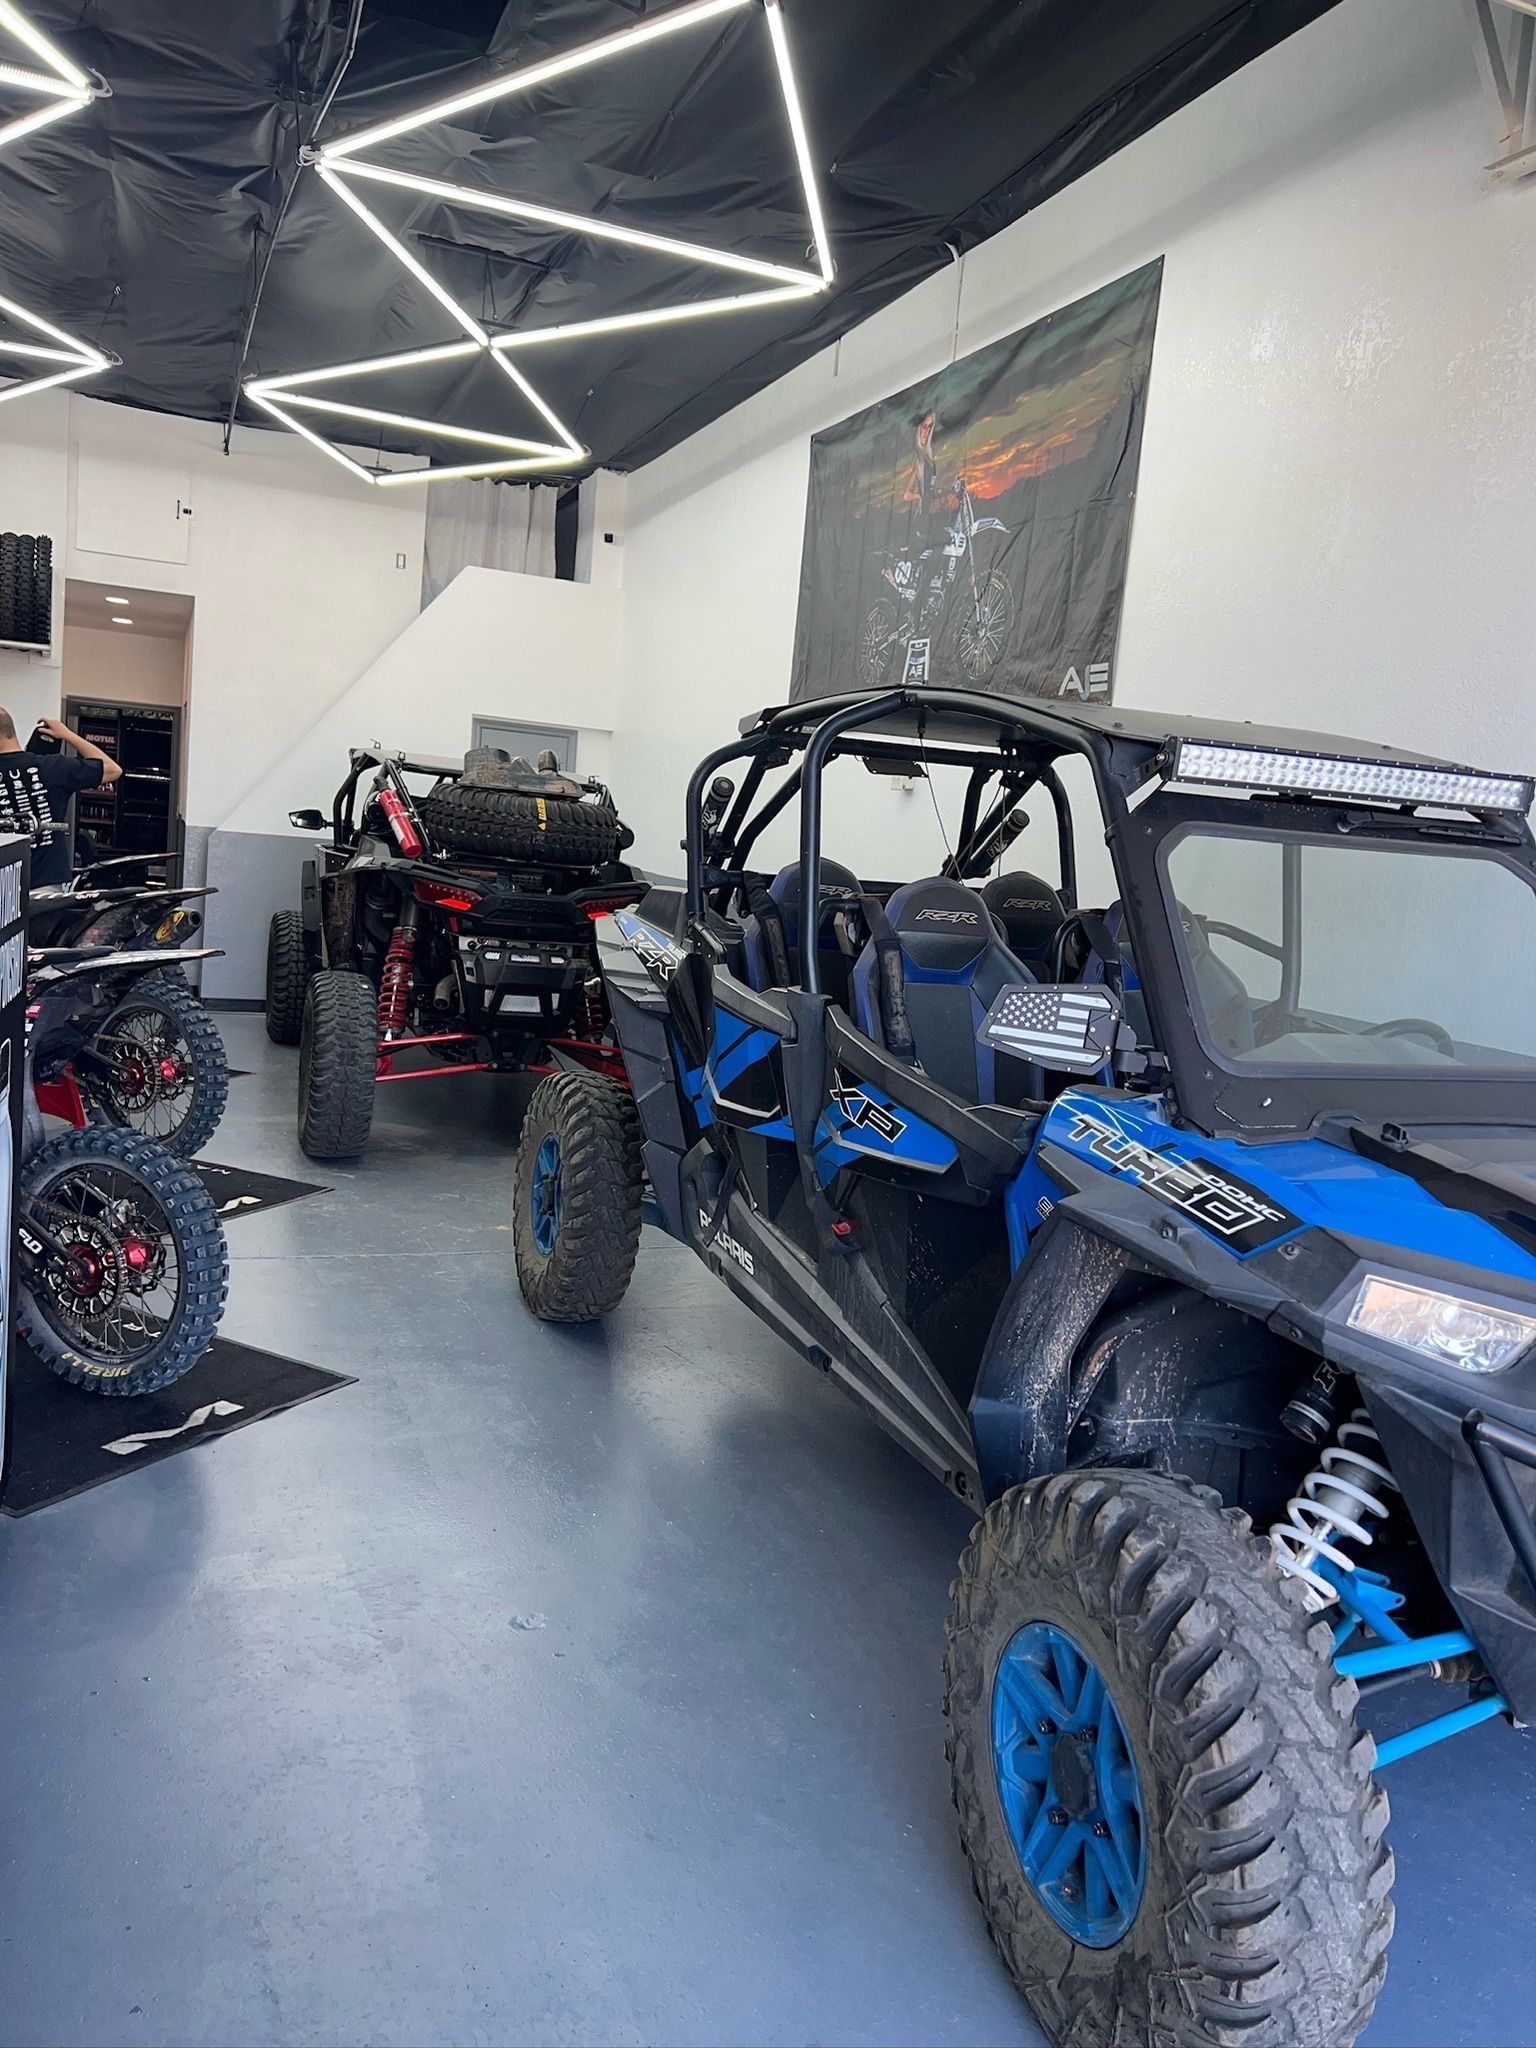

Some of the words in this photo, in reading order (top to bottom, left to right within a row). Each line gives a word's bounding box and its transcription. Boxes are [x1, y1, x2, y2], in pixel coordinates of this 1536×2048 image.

[85, 733, 117, 743] MOTUL
[818, 884, 853, 897] ZR
[1002, 897, 1053, 911] RZR
[915, 908, 979, 925] RZR
[628, 927, 679, 981] RZR
[829, 1066, 908, 1143] XP
[1067, 1114, 1267, 1236] TURBO
[1202, 1174, 1287, 1223] DOHC
[699, 1207, 755, 1277] PLARIS
[61, 1351, 134, 1378] PIRELLI
